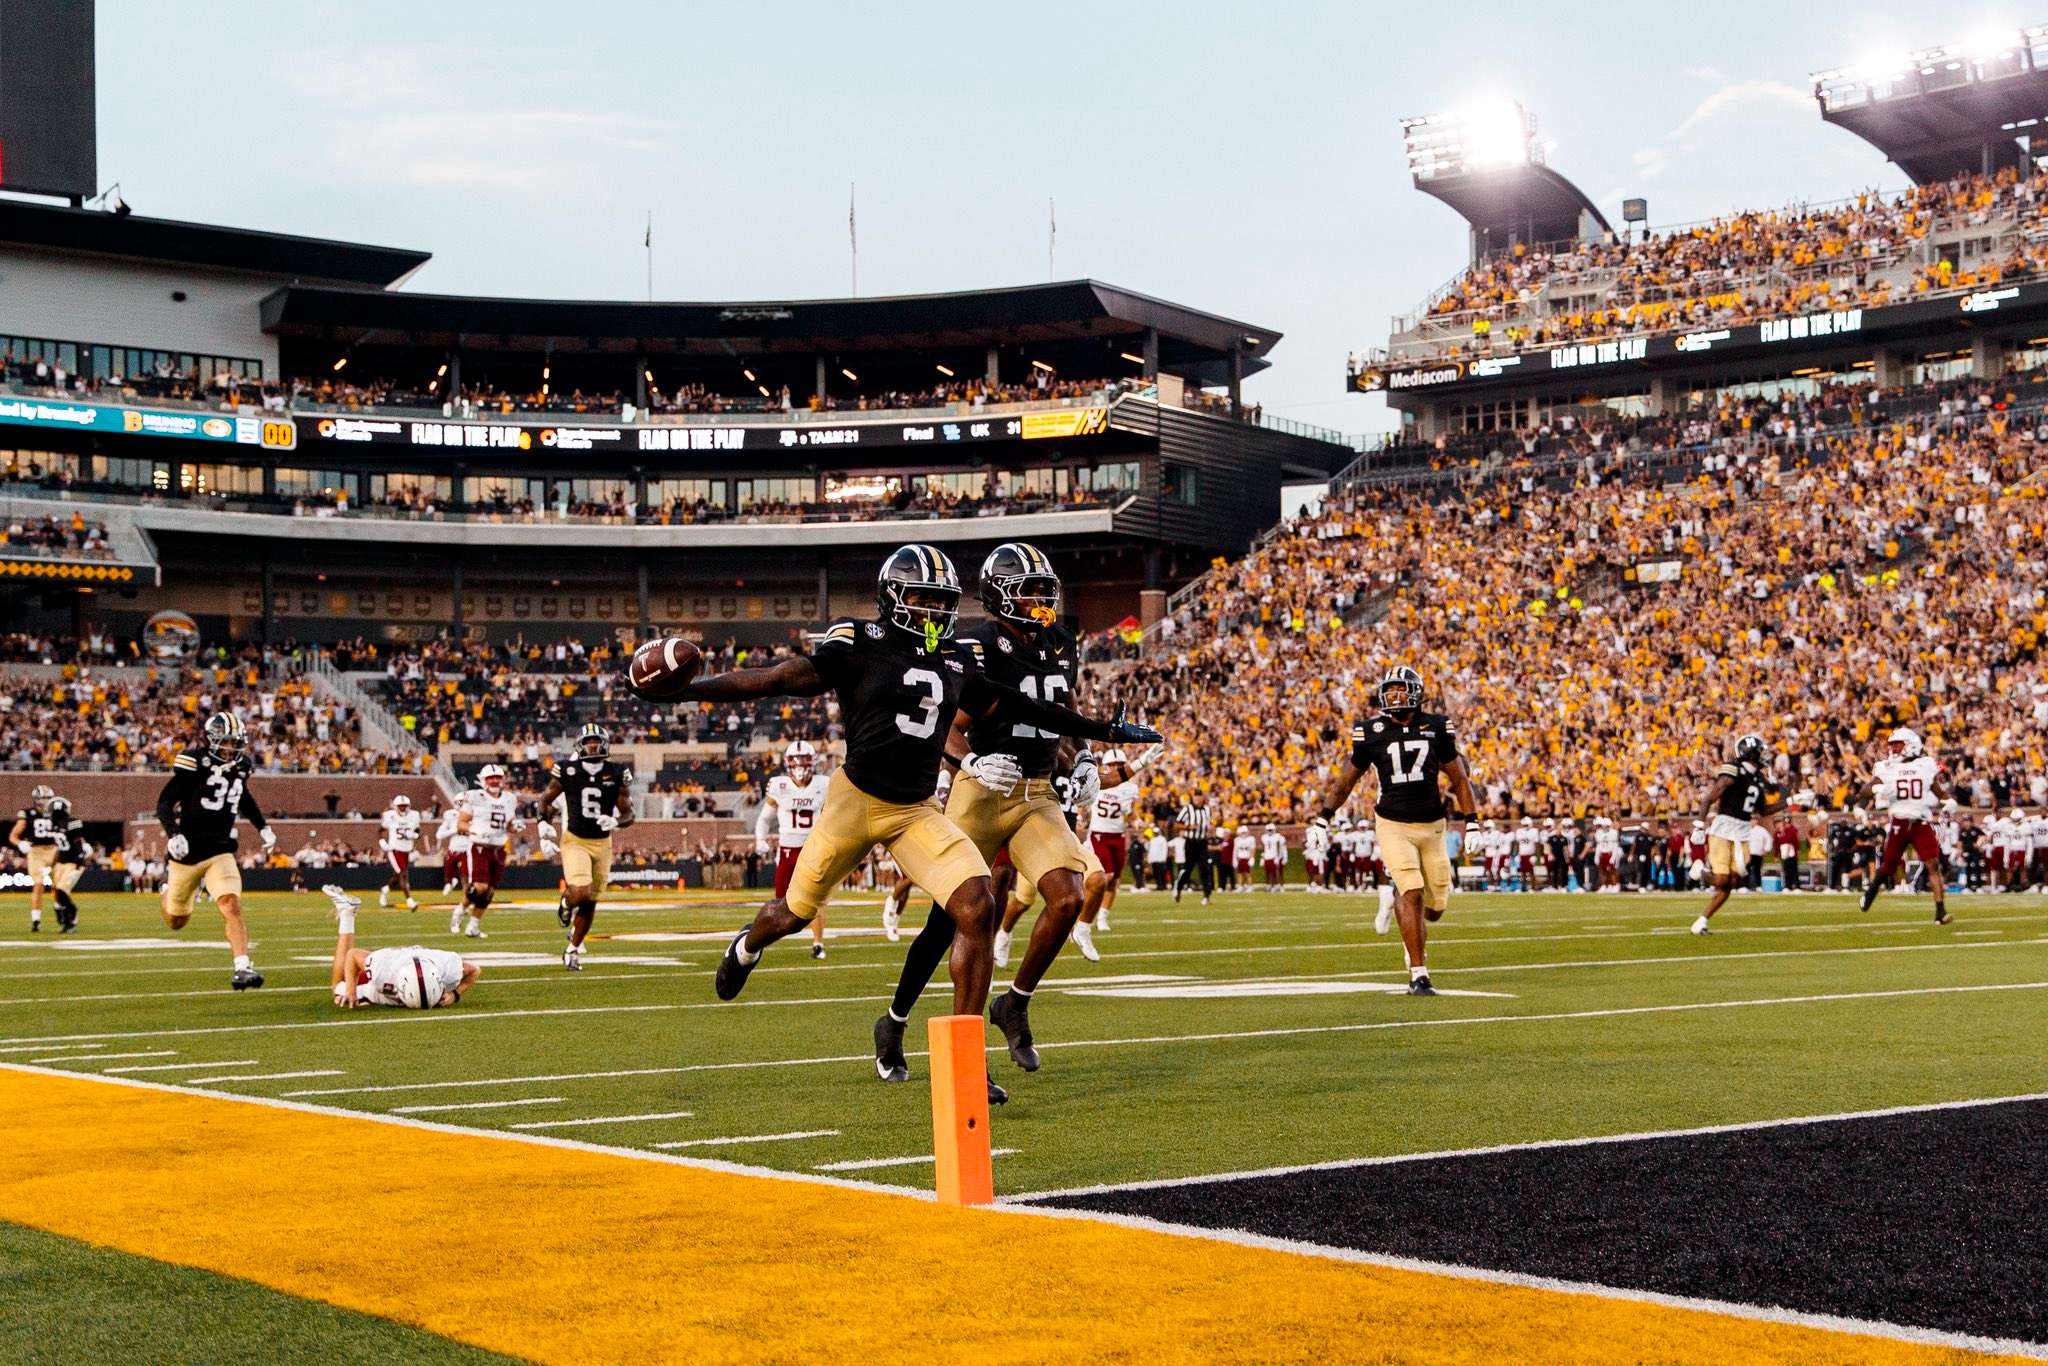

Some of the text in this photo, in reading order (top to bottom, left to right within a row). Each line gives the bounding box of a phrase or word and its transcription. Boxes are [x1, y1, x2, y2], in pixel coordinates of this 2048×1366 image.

[1760, 320, 1789, 342] FLAG
[1810, 313, 1832, 336] THE
[1833, 310, 1862, 333] PLAY
[1551, 347, 1578, 368] FLAG
[1597, 342, 1618, 363] THE
[1620, 339, 1647, 360] PLAY
[1390, 368, 1457, 389] Mediacom
[264, 423, 293, 446] 00
[411, 423, 442, 445] FLAG
[464, 426, 488, 447] THE
[489, 427, 521, 447] PLAY
[639, 429, 669, 449] FLAG
[690, 429, 713, 449] THE
[714, 429, 745, 449] PLAY
[903, 427, 934, 441] Final
[896, 668, 943, 739] 3
[1387, 740, 1429, 784] 17
[200, 775, 243, 814] 34
[1742, 785, 1759, 813] 2
[1897, 779, 1922, 800] 60
[582, 787, 602, 818] 6
[793, 798, 814, 807] TROY
[1097, 800, 1122, 819] 52
